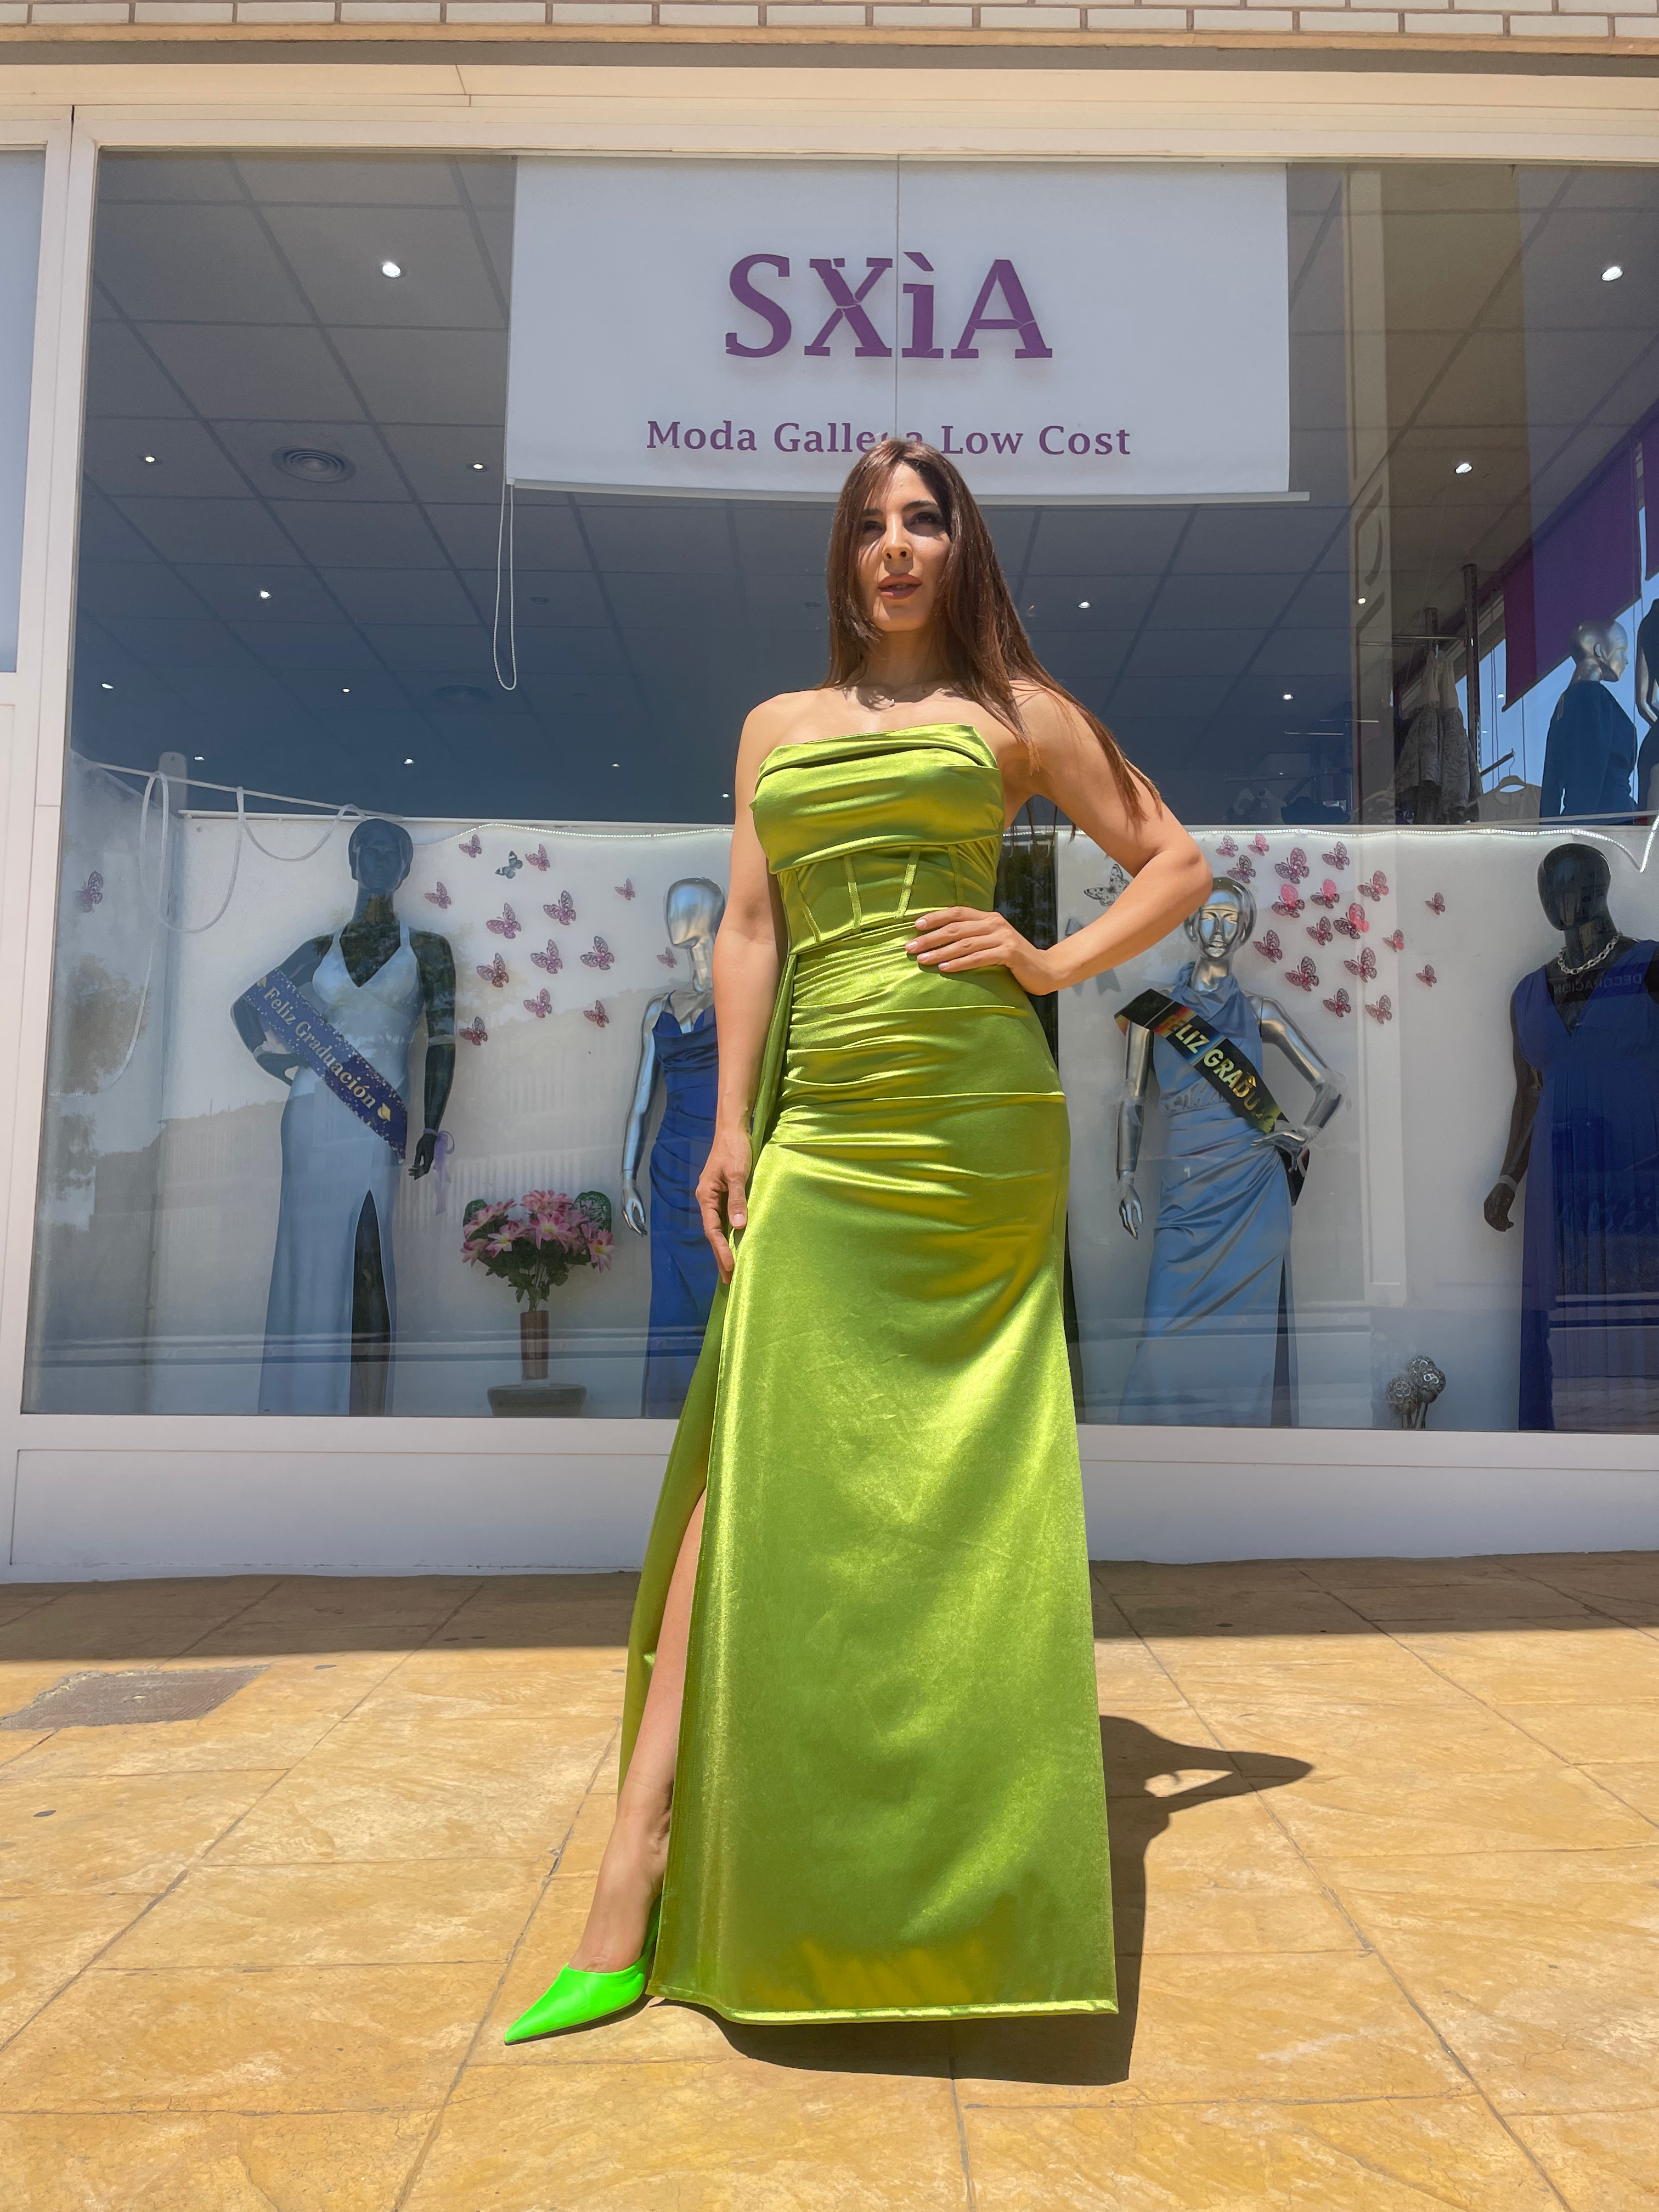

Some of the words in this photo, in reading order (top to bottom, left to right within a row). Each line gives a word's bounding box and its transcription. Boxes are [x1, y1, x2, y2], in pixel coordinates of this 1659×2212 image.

[647, 420, 757, 451] Moda
[774, 421, 924, 454] Galle
[941, 425, 1024, 454] Low
[1039, 425, 1130, 455] Cost
[263, 986, 296, 1025] Feliz
[295, 1020, 376, 1109] Graduación
